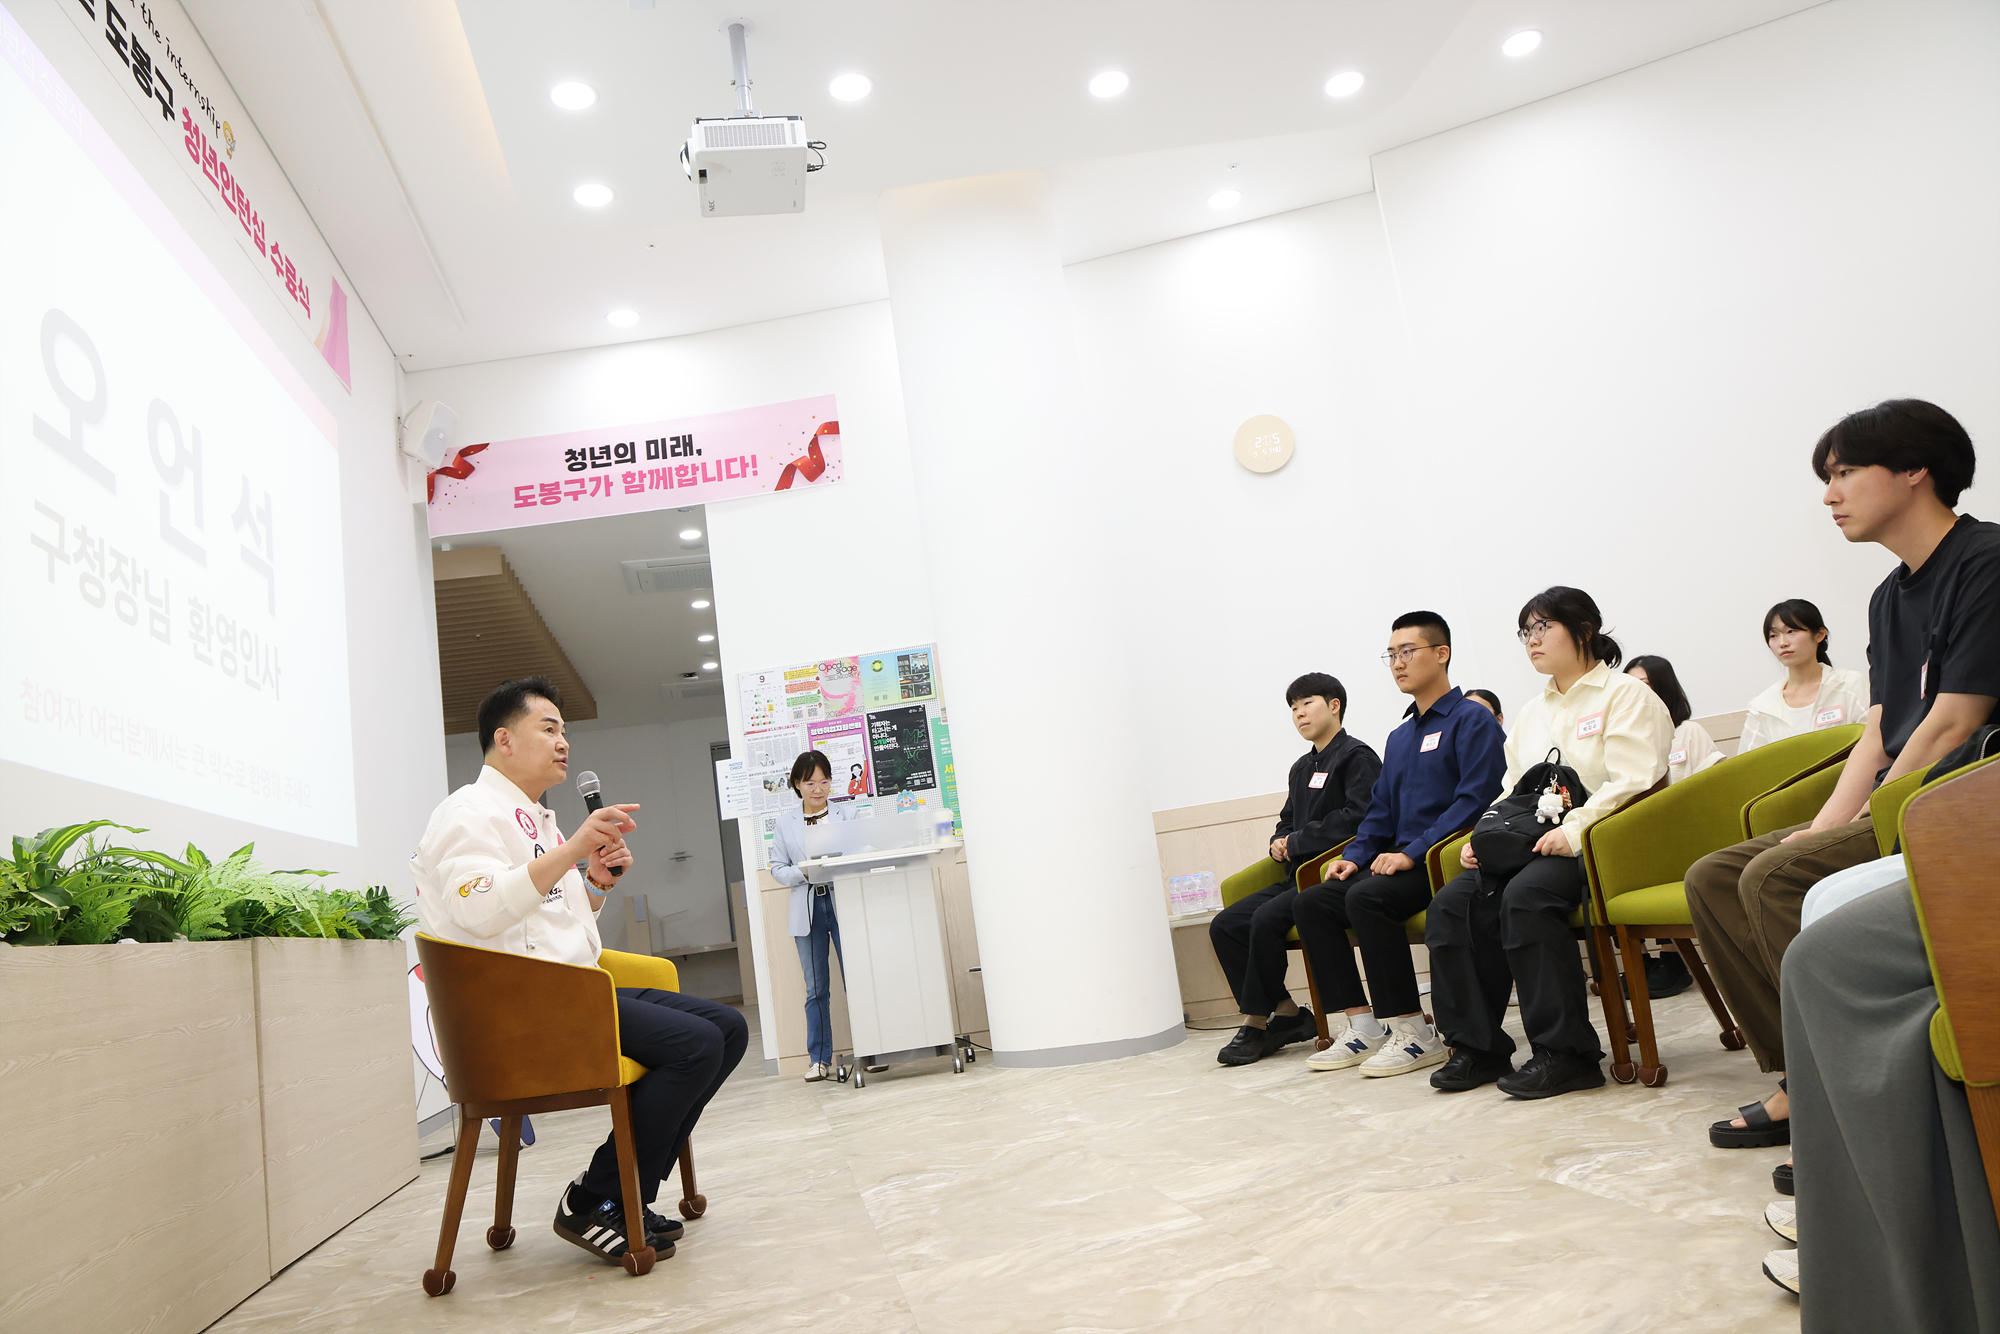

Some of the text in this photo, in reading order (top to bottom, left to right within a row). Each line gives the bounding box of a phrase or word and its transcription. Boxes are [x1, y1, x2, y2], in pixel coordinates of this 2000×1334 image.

[140, 2, 221, 139] the internship
[105, 0, 311, 320] 도봉구 청년인턴십 수료식
[32, 308, 277, 620] 오 언 석
[513, 454, 759, 509] 도봉구가 함께합니다!
[564, 433, 702, 472] 청년의 미래,
[30, 498, 282, 702] 구청장님 환영인사
[20, 677, 313, 809] 참여자 여러분께서는 큰 박수로 환영해 주세요
